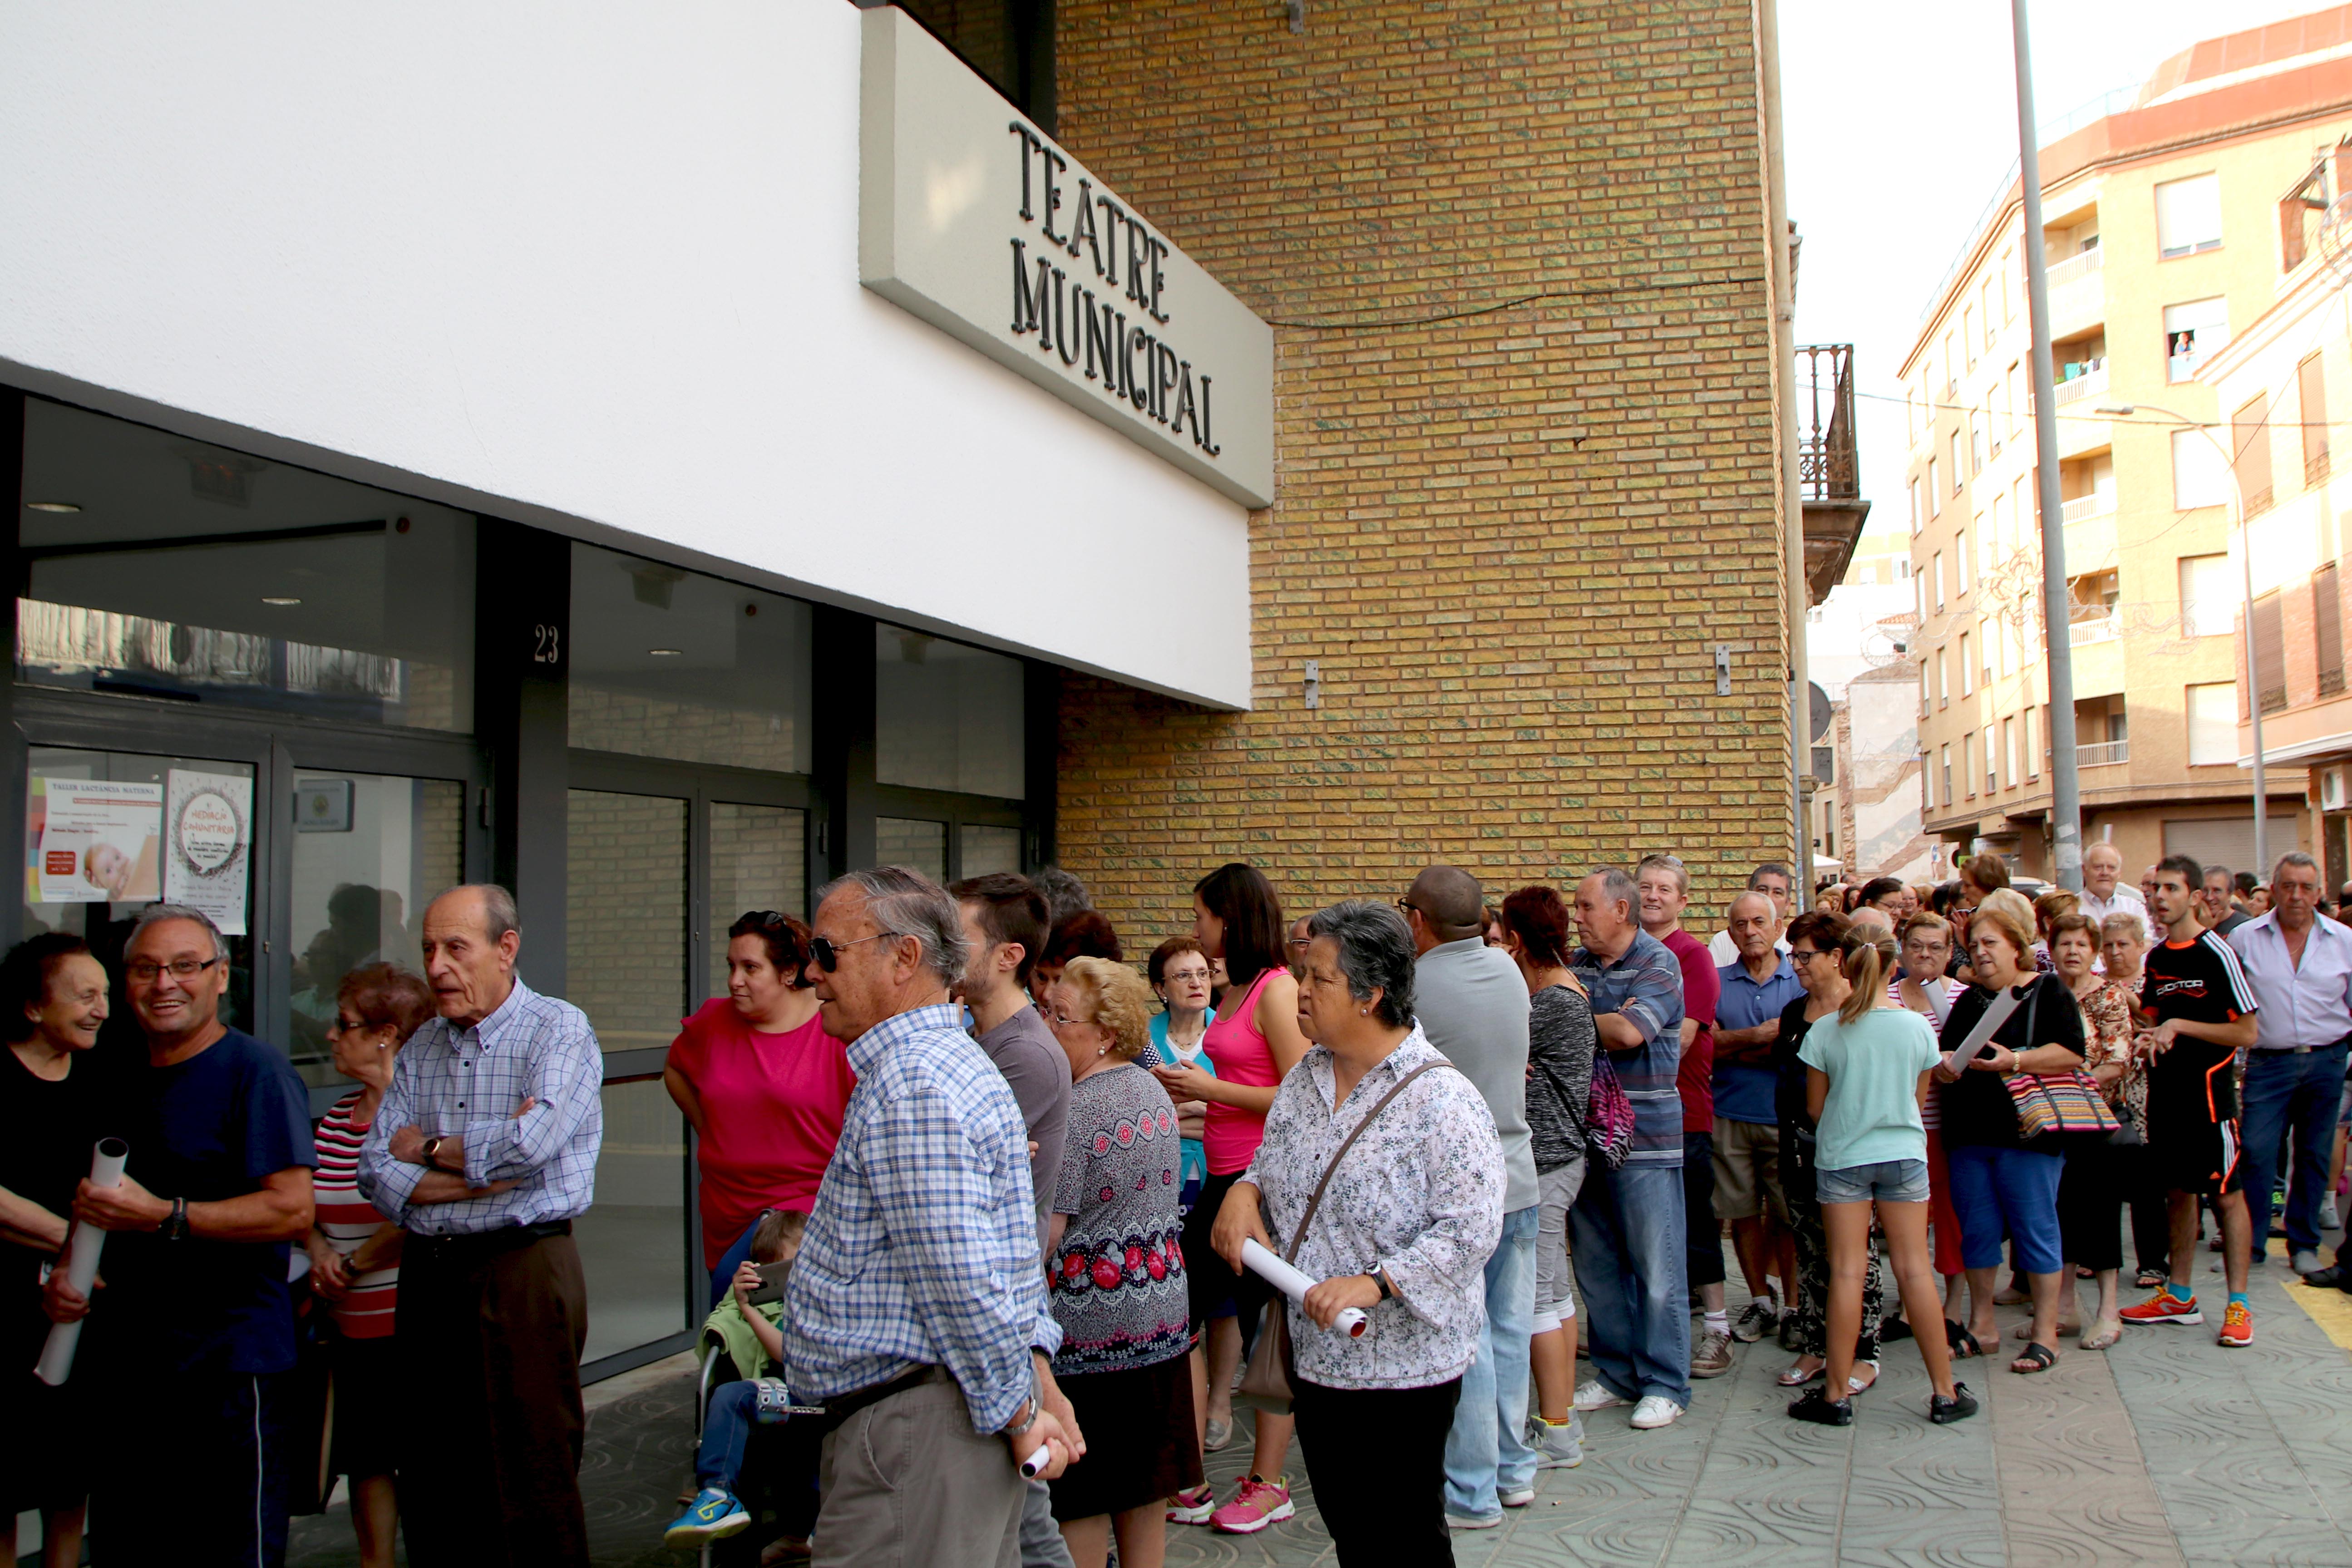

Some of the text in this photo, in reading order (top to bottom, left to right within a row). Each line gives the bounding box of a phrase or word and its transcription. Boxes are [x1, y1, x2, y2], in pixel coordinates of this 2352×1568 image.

[1009, 120, 1169, 323] TEATRE
[1011, 237, 1220, 455] MUNICIPAL
[535, 624, 558, 664] 23
